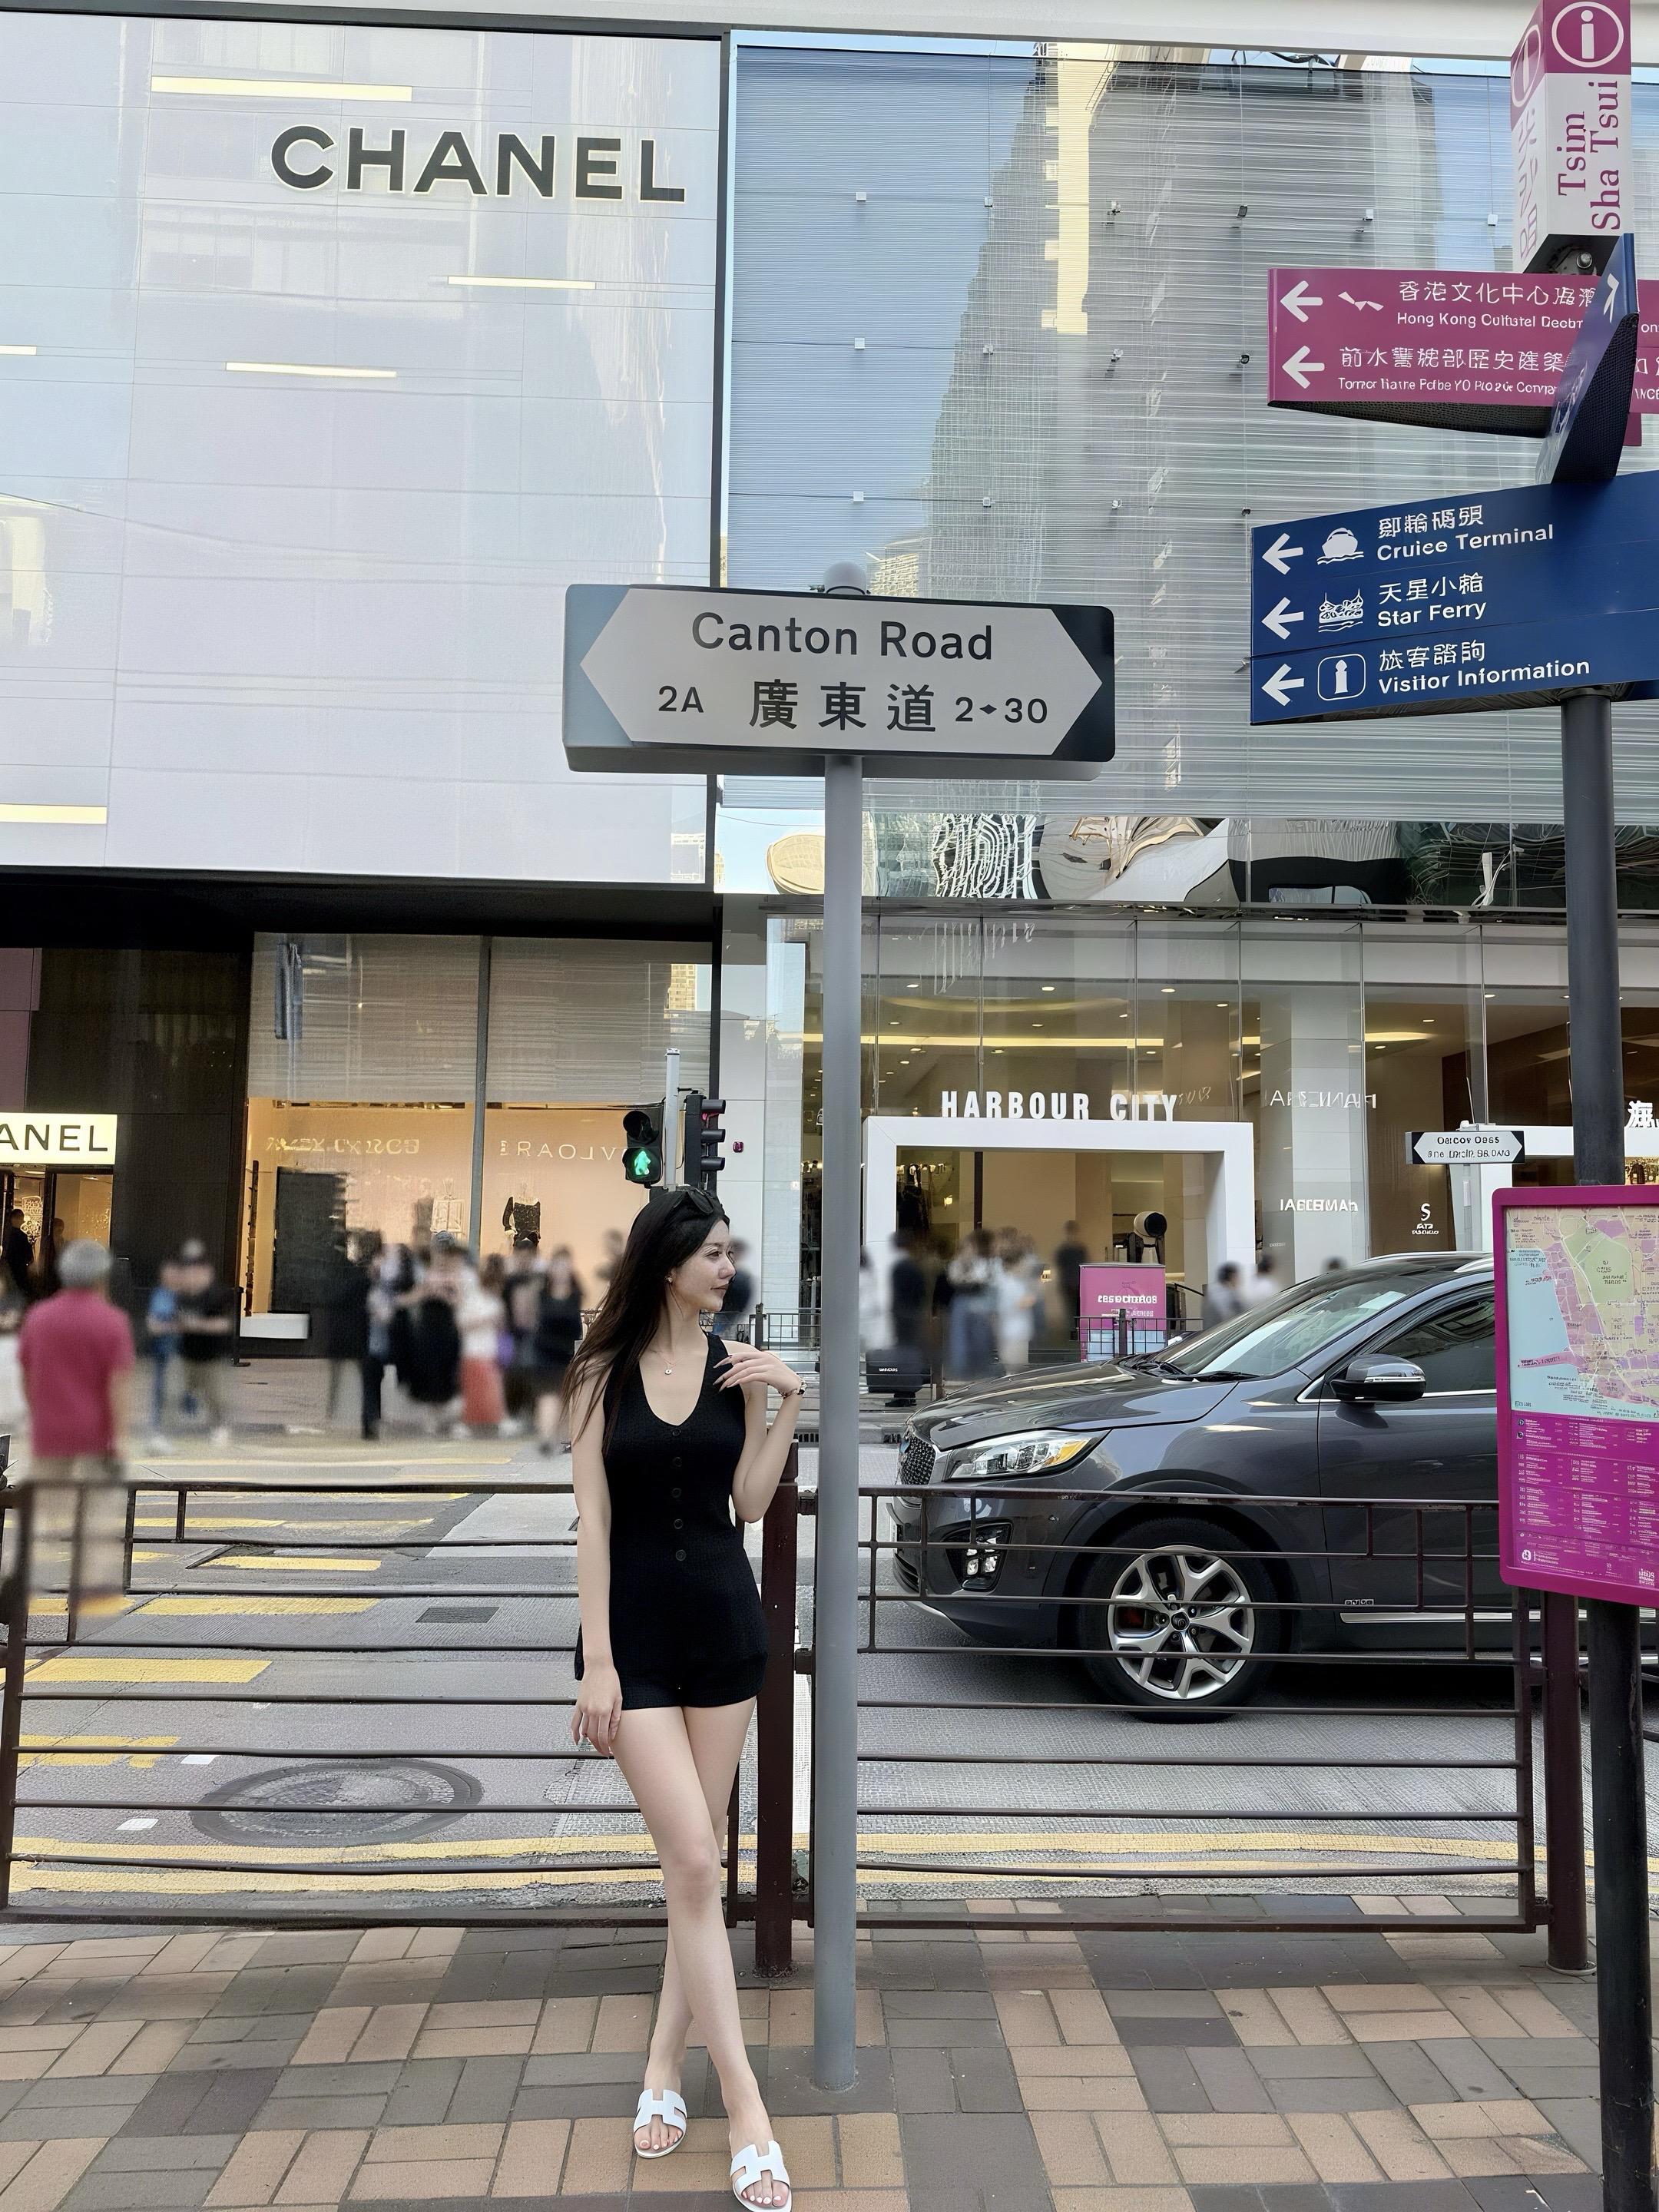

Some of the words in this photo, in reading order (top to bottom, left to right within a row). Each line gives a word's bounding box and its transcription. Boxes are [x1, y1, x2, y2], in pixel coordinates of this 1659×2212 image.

[1588, 81, 1619, 153] Tsui
[271, 125, 685, 202] CHANEL
[1557, 111, 1586, 196] Tsim
[1590, 170, 1621, 230] Sha
[1398, 313, 1434, 327] Hong
[1439, 313, 1476, 329] Kong
[1455, 524, 1553, 550] Terminal
[691, 611, 858, 656] Canton
[880, 620, 992, 661] Road
[1378, 610, 1422, 628] Star
[1429, 602, 1487, 621] Ferry
[1379, 674, 1450, 694] Visitor
[1459, 660, 1590, 687] Information
[657, 685, 704, 714] 2A
[750, 679, 935, 733] 廣東道
[942, 1091, 1089, 1120] HARBOUR
[1110, 1093, 1177, 1122] CITY
